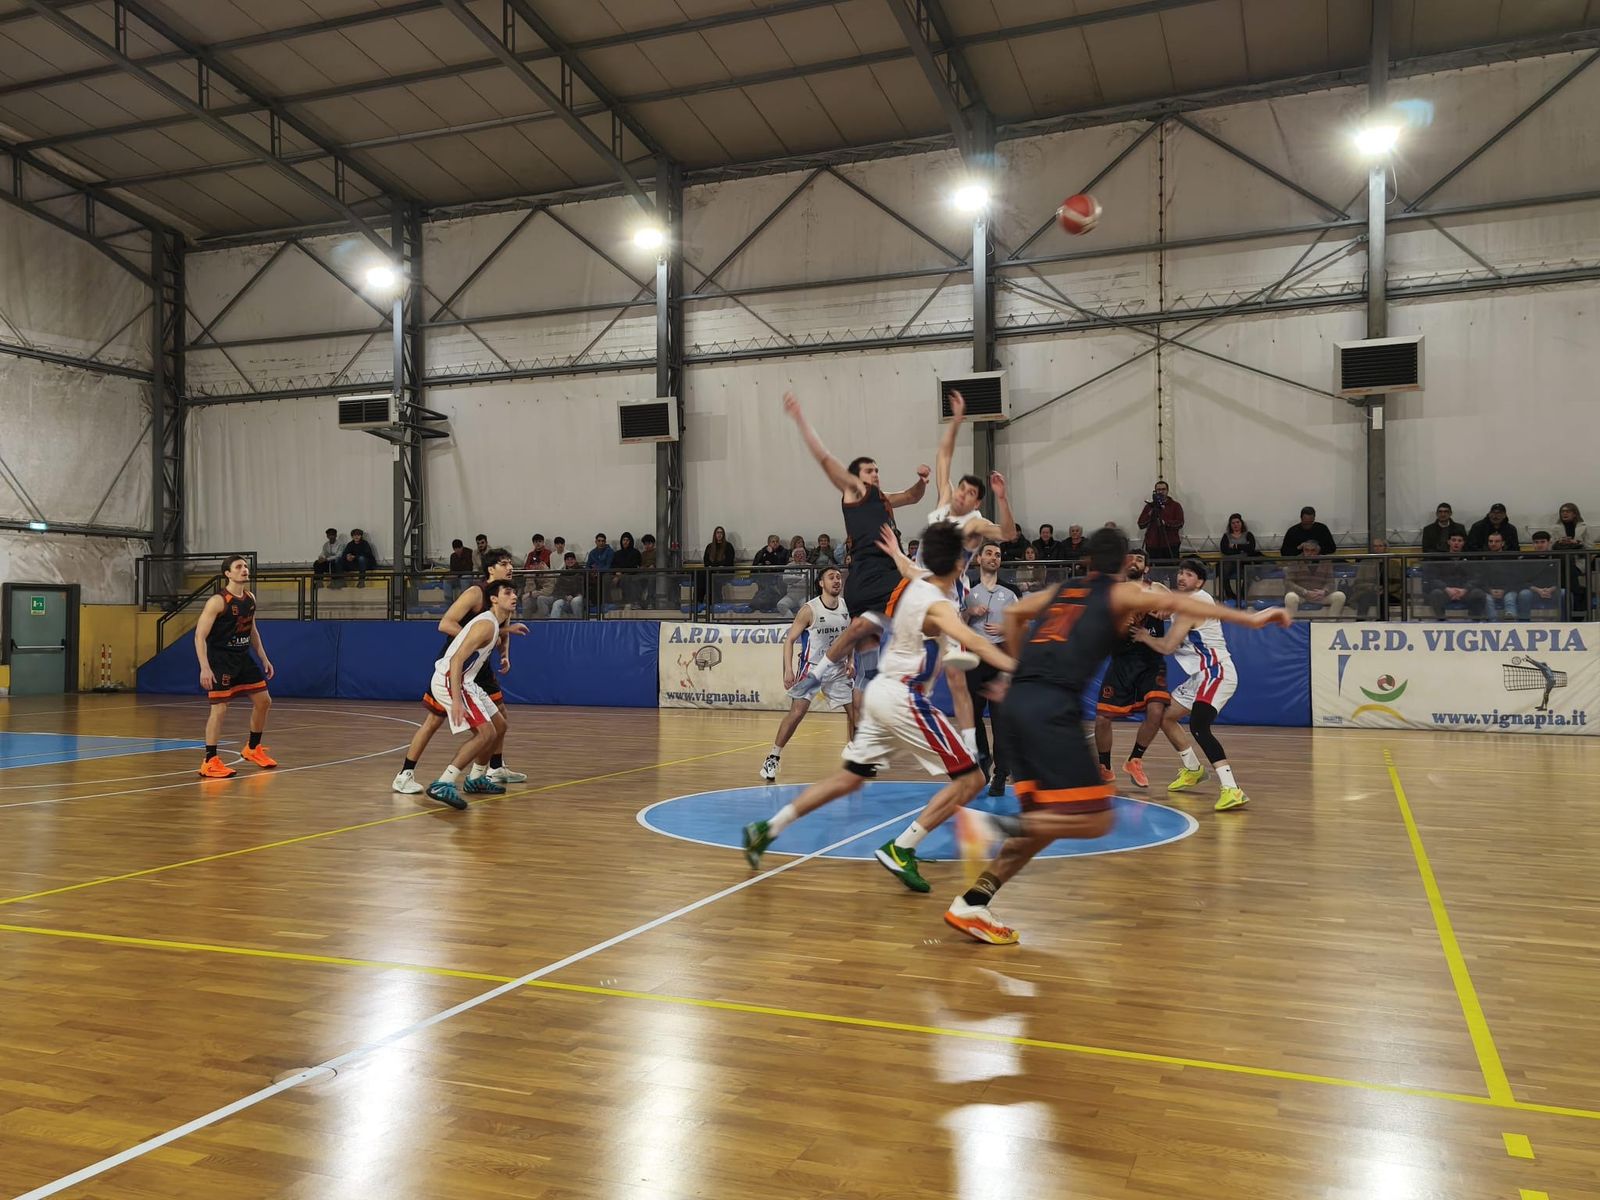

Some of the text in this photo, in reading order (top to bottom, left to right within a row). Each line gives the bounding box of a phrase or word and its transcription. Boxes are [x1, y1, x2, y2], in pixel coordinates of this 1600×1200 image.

[668, 625, 723, 643] A.P.D.
[817, 627, 840, 635] VIGNA
[1328, 628, 1588, 652] A.P.D. VIGNAPIA
[666, 690, 760, 705] www.vignapia.it
[1431, 709, 1588, 729] www.vignapia.it
